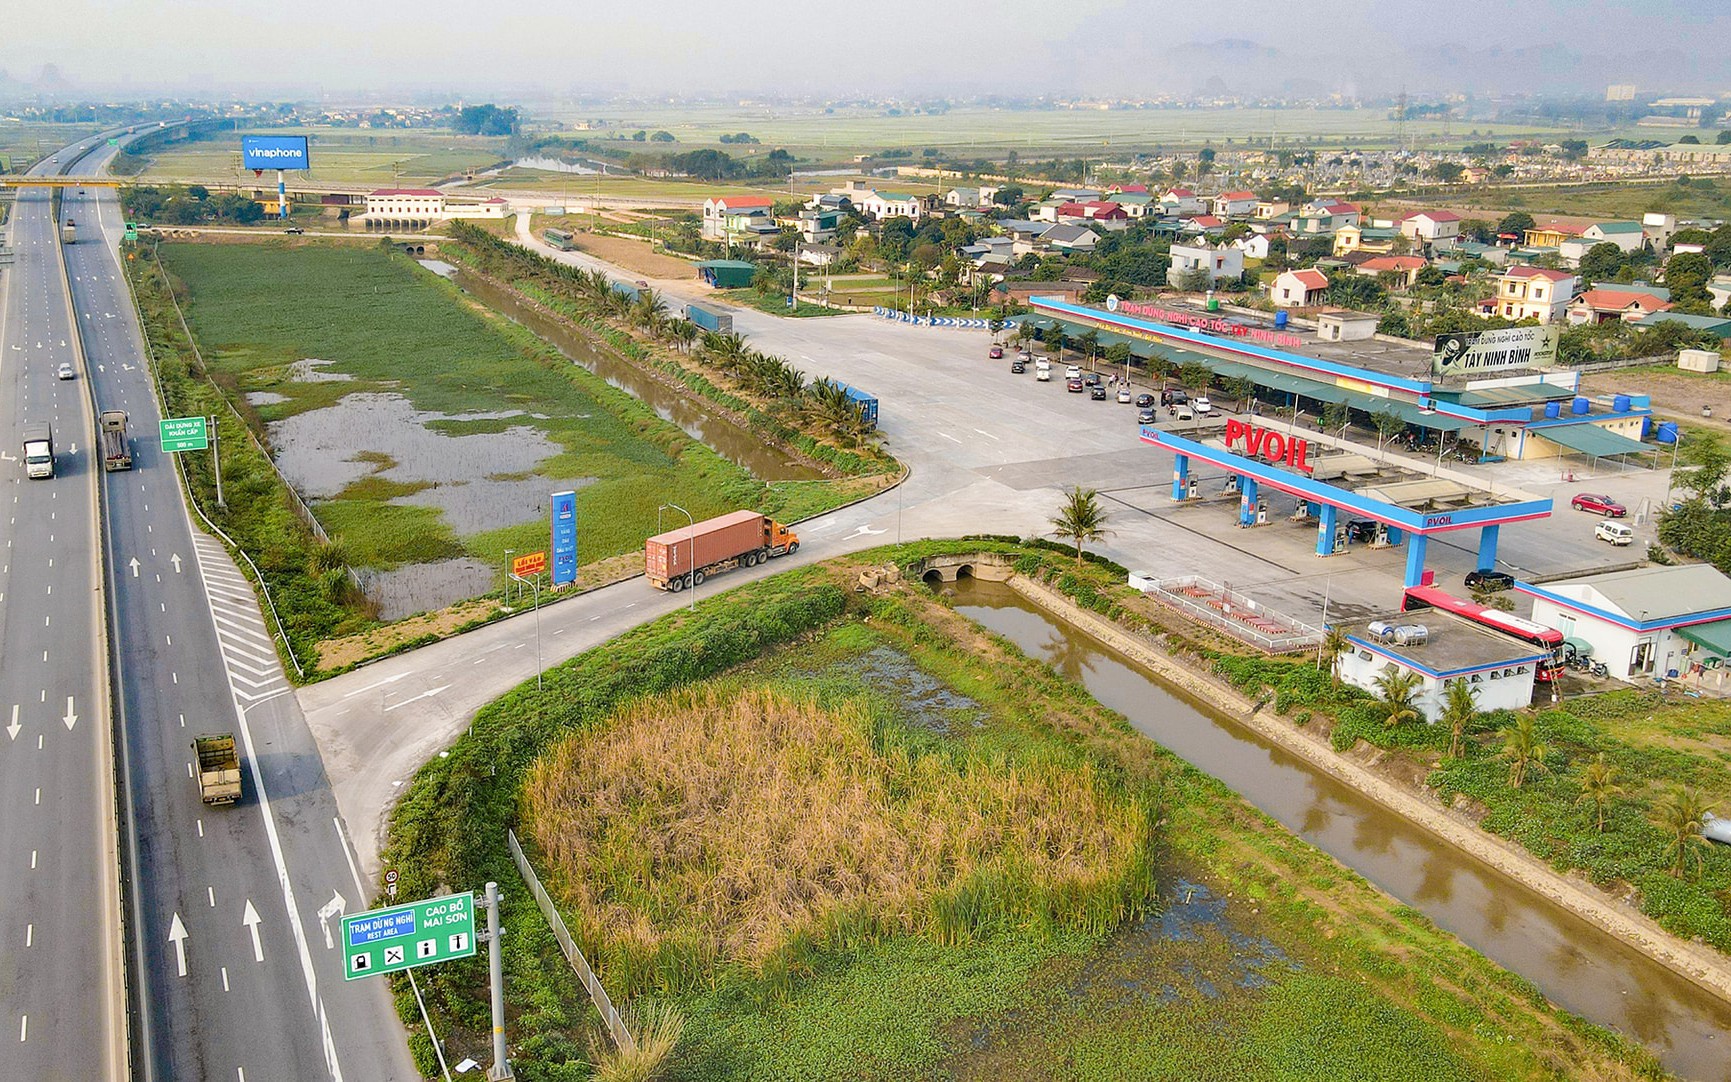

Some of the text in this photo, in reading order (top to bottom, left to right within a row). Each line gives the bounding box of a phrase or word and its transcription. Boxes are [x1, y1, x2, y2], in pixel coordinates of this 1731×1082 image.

[248, 147, 302, 159] vinaphone
[1189, 316, 1208, 328] CAO
[1483, 350, 1507, 366] NINH
[1225, 418, 1314, 473] PVOIL
[1427, 516, 1452, 527] PVOIL
[387, 872, 396, 880] 50
[425, 905, 447, 917] CAO
[350, 923, 371, 934] TRẠM
[373, 917, 394, 930] DỪNG
[423, 911, 467, 928] MAI SƠN
[367, 928, 398, 940] REST AREA
